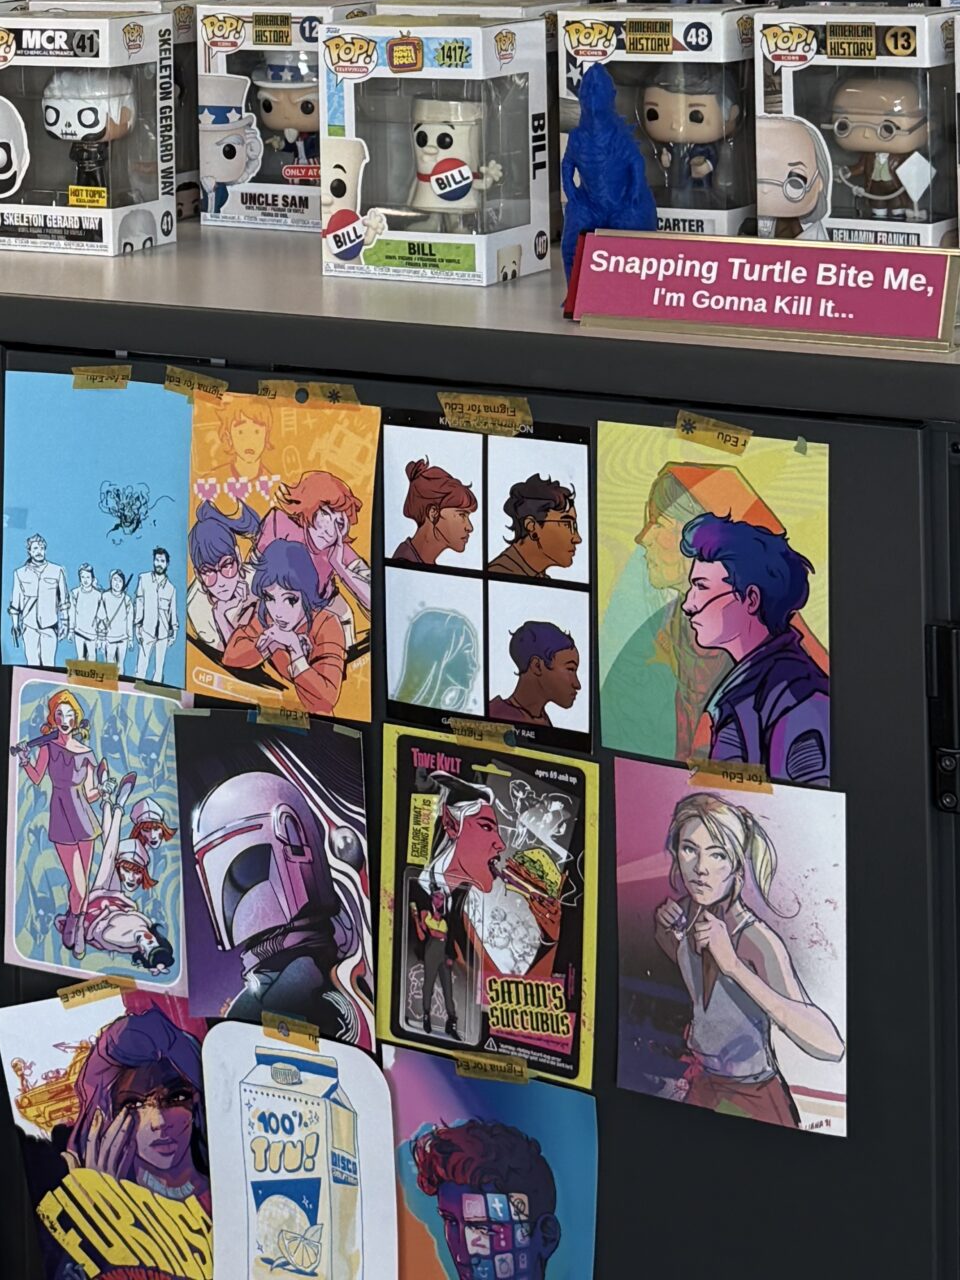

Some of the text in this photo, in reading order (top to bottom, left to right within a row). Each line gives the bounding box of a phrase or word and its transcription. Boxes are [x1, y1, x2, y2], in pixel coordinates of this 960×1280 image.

[122, 24, 144, 43] POP!
[201, 15, 244, 41] POP!
[255, 29, 289, 42] HISTORY
[564, 21, 708, 48] POP! AMERICAN 48
[22, 30, 68, 49] MCR
[76, 34, 97, 53] 41
[323, 35, 464, 66] POP! 1417
[494, 31, 516, 53] POP!
[628, 37, 670, 52] HISTORY
[761, 25, 911, 54] POP! AMERICAN 13
[829, 41, 873, 56] HISTORY
[158, 28, 174, 197] SKELETON GERARD WAY
[531, 112, 546, 180] BILL
[285, 167, 317, 177] ONLY AT
[434, 169, 470, 191] BILL
[70, 188, 105, 199] HOT TOPIC
[241, 192, 309, 209] UNCLE SAM
[4, 212, 99, 230] SKELETON GERARD WAY
[657, 218, 704, 232] CARTER
[333, 226, 363, 249] BILL
[408, 242, 436, 257] BILL
[590, 249, 935, 297] Snapping Turtle Bite Me,
[652, 287, 855, 319] I'm Gonna Kill It...
[444, 401, 515, 417] Figma for Edu
[717, 430, 740, 447] Edu
[198, 673, 213, 683] HP
[722, 769, 763, 786] for Edu
[411, 805, 422, 858] EXPLORE WHAT
[487, 976, 565, 1011] SATAN'S
[489, 1006, 571, 1036] SUCCUBUS
[257, 1110, 310, 1136] 100%
[331, 1150, 358, 1176] DISCO
